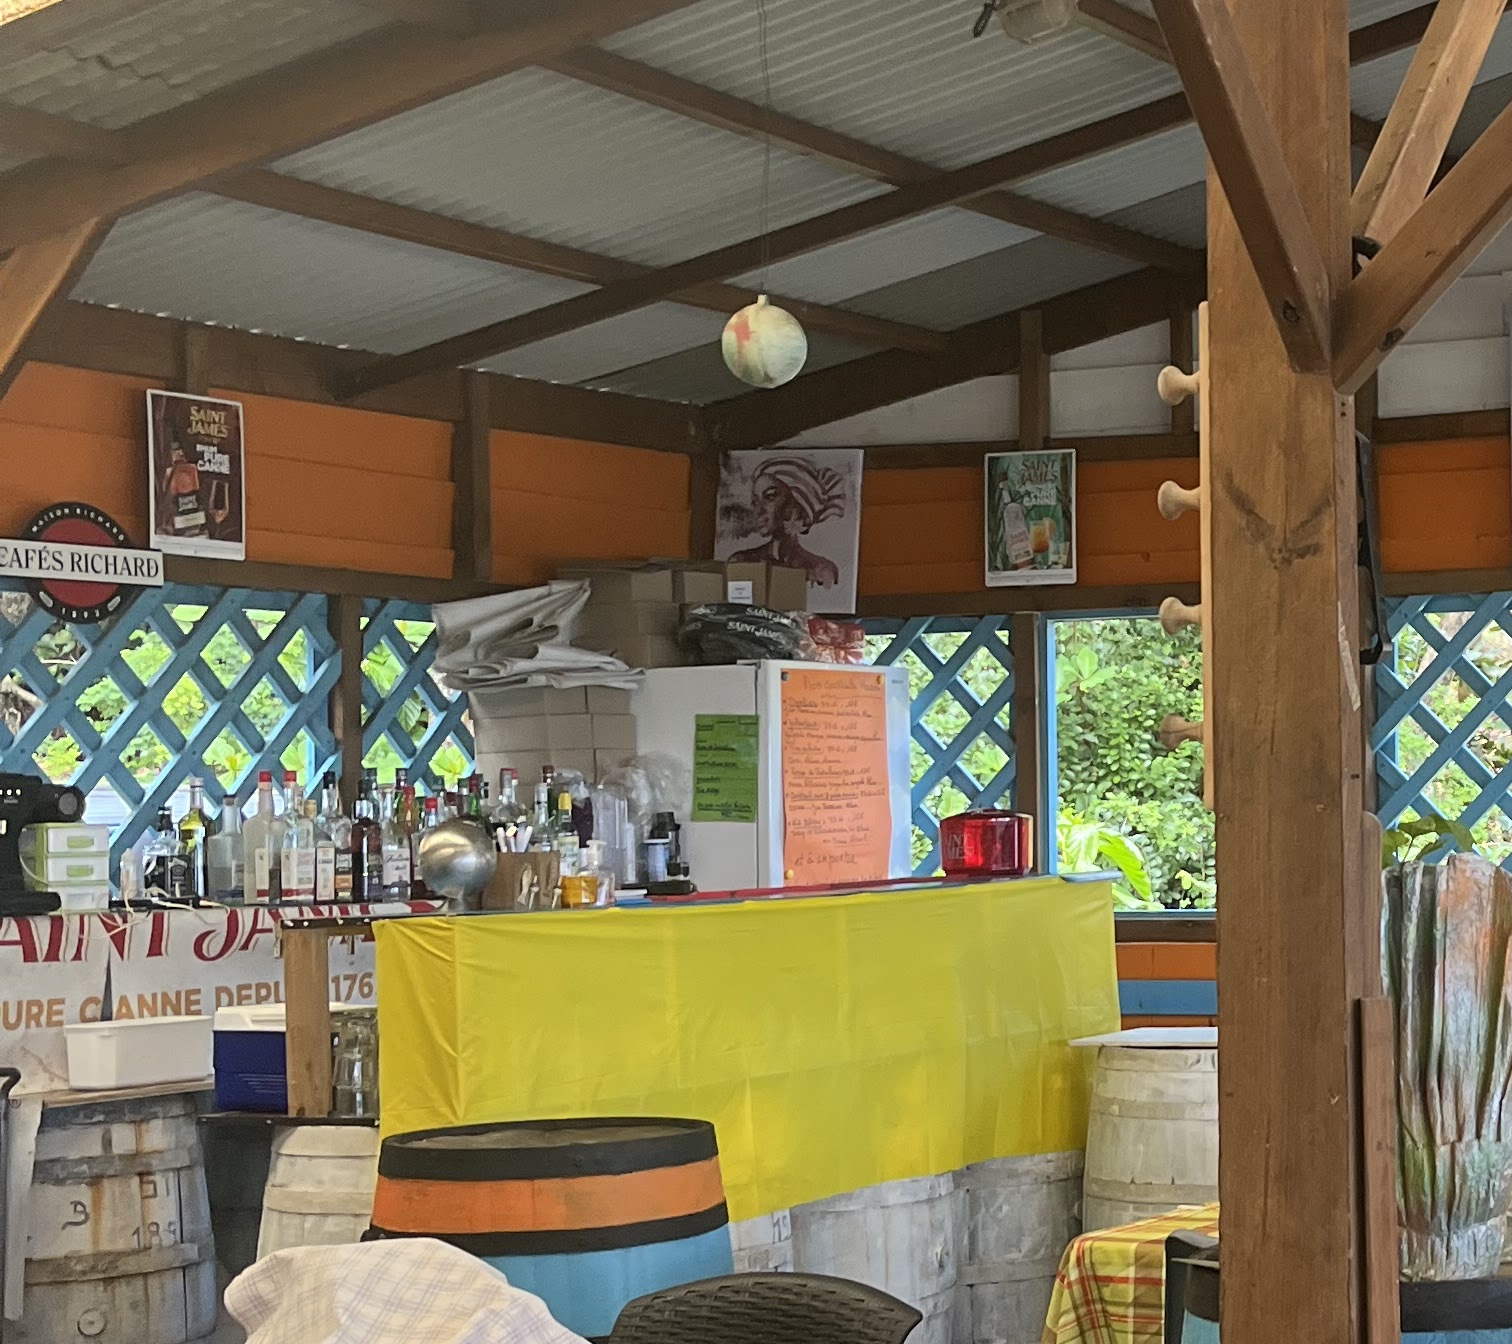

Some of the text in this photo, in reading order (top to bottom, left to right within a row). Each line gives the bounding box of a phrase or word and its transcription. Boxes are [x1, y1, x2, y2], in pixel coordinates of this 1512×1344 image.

[188, 405, 227, 425] SAINT
[186, 420, 229, 438] JAMES
[0, 545, 159, 579] CAFÉS RICHARD
[0, 997, 66, 1031] URE
[331, 972, 376, 1002] 176
